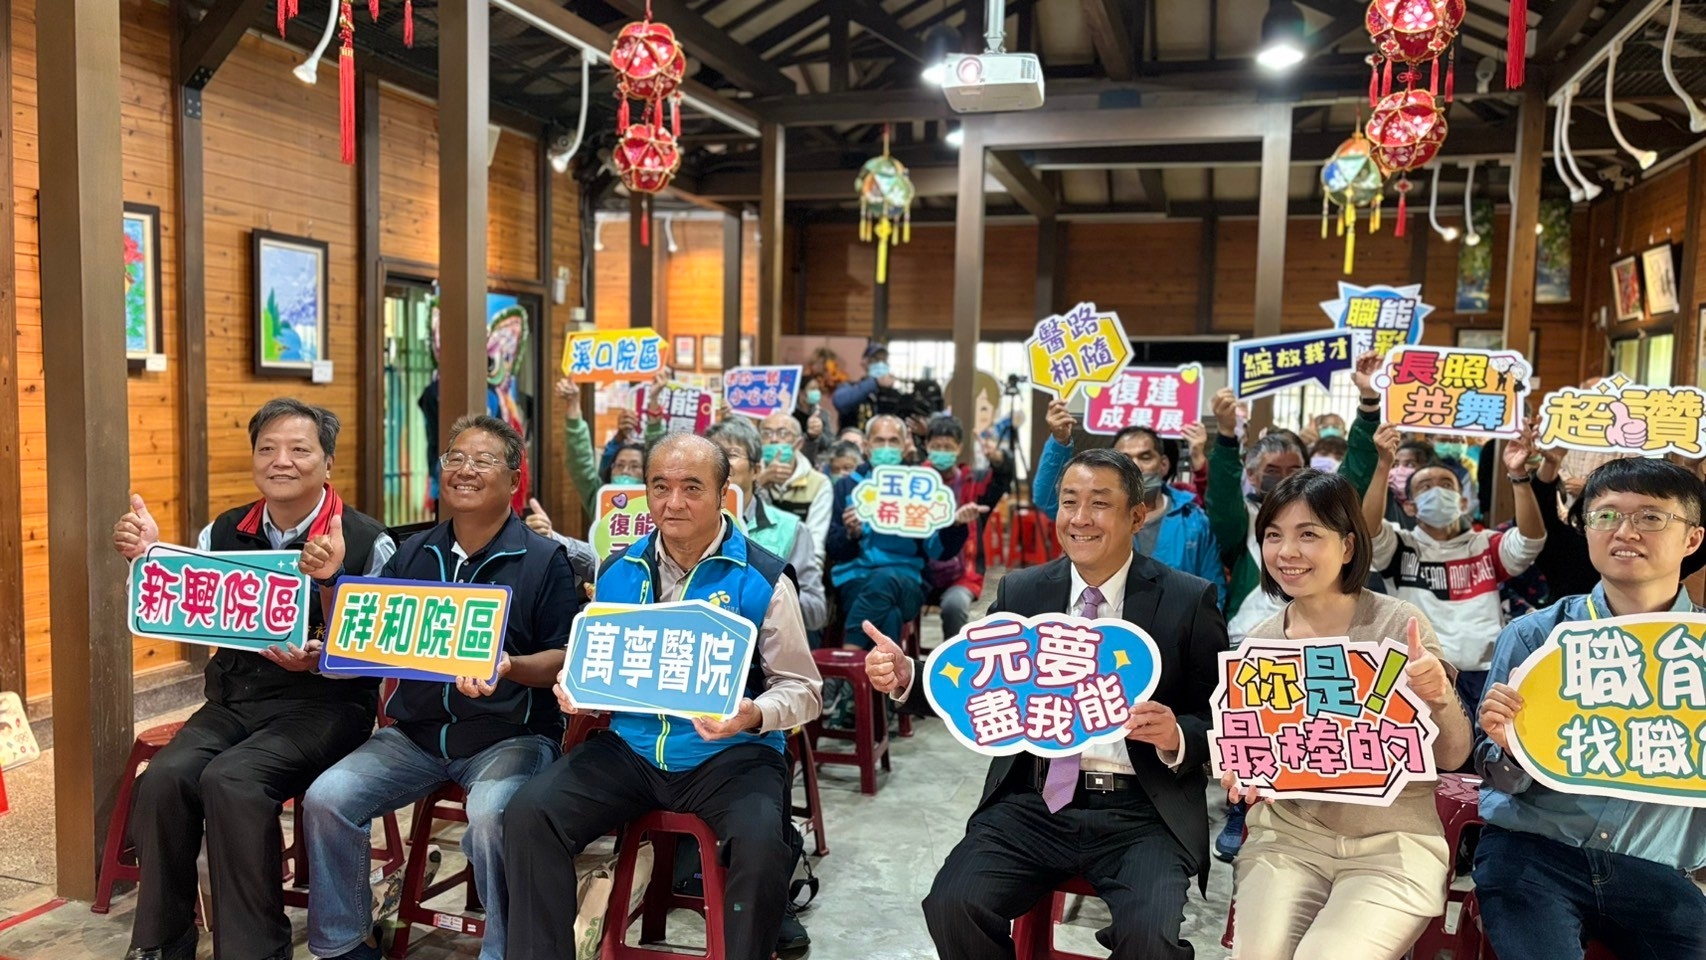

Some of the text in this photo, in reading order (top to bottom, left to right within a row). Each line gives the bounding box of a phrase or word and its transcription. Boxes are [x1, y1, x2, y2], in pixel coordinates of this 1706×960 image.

[1039, 306, 1098, 354] 醫路
[1345, 297, 1416, 329] 職能
[571, 337, 660, 371] 溪口院區
[1050, 337, 1114, 386] 相隨
[1243, 337, 1348, 379] 綻放我才
[1394, 350, 1490, 388] 長照
[1108, 373, 1180, 407] 復建
[1402, 386, 1507, 432] 共舞
[1097, 406, 1184, 432] 成果展
[1541, 388, 1702, 454] 超讚
[880, 474, 933, 501] 玉見
[877, 501, 929, 528] 希望
[138, 561, 300, 632] 新興院區
[337, 593, 500, 660] 祥和院區
[581, 621, 735, 696] 萬寧醫院
[966, 622, 1102, 687] 元夢
[966, 674, 1131, 745] 盡我能
[1216, 711, 1425, 780] 最棒的
[1558, 714, 1706, 779] 找職
